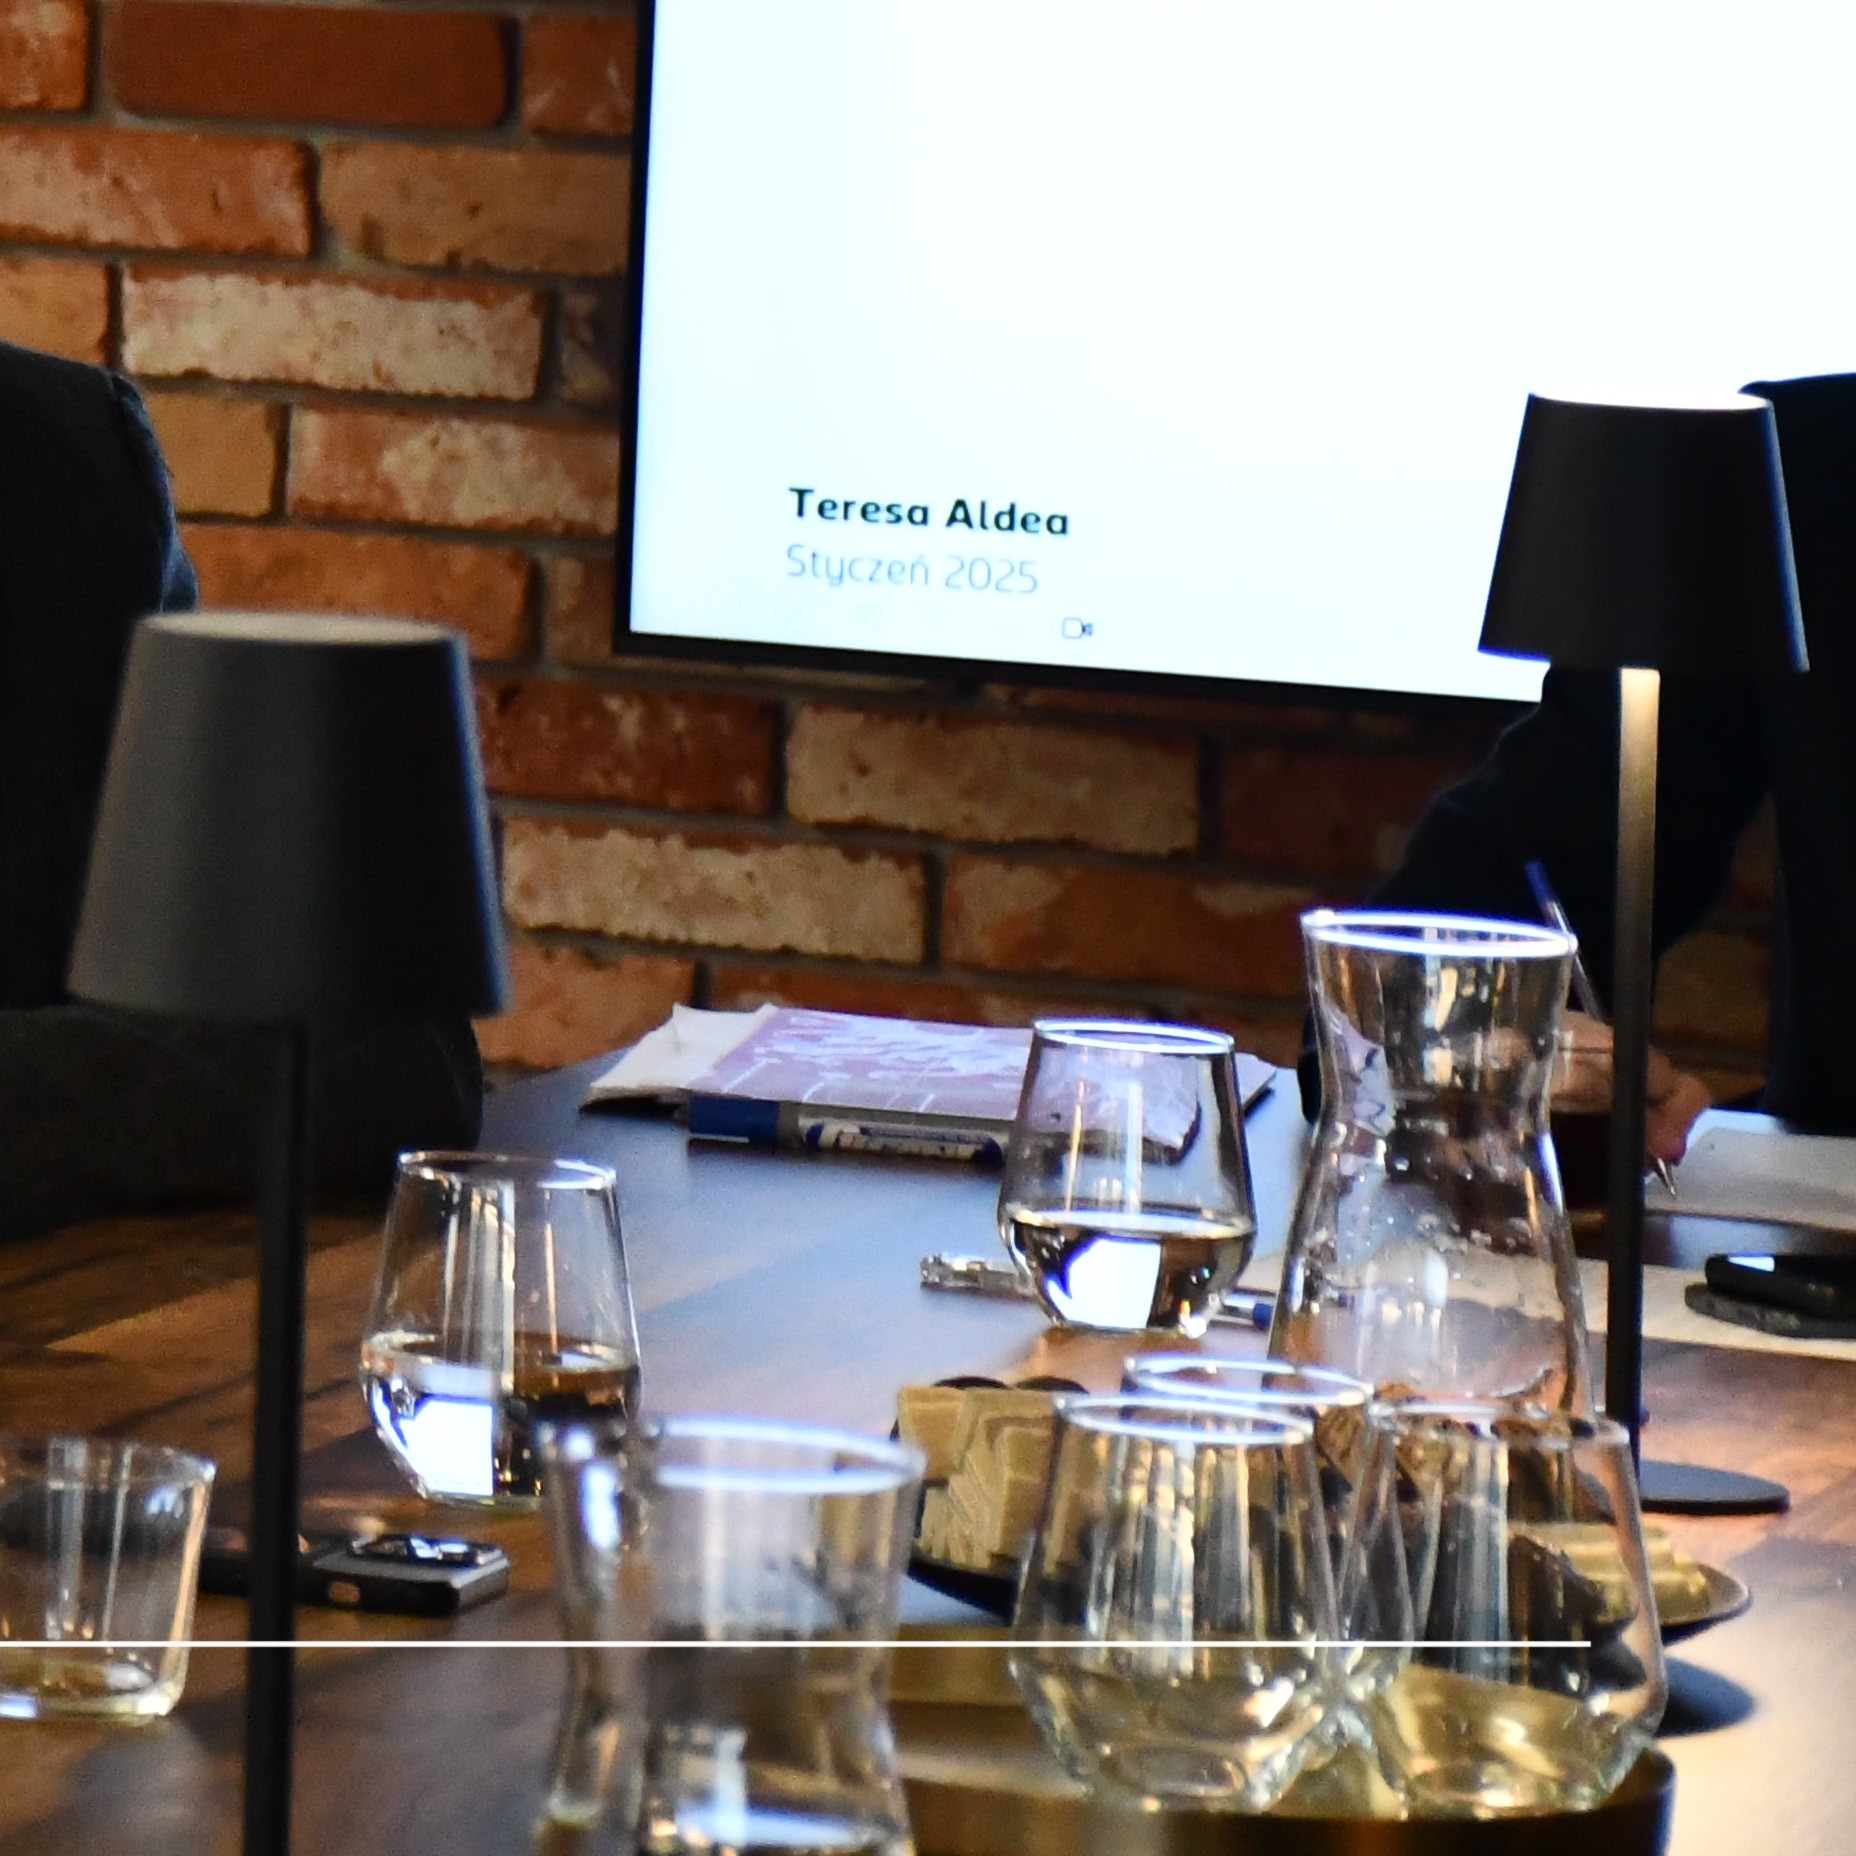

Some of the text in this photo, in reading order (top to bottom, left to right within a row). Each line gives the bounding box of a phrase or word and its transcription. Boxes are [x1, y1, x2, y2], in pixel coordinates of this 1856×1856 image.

[789, 486, 1070, 536] Teresa Aldea
[787, 543, 1038, 594] Styczeń 2025
